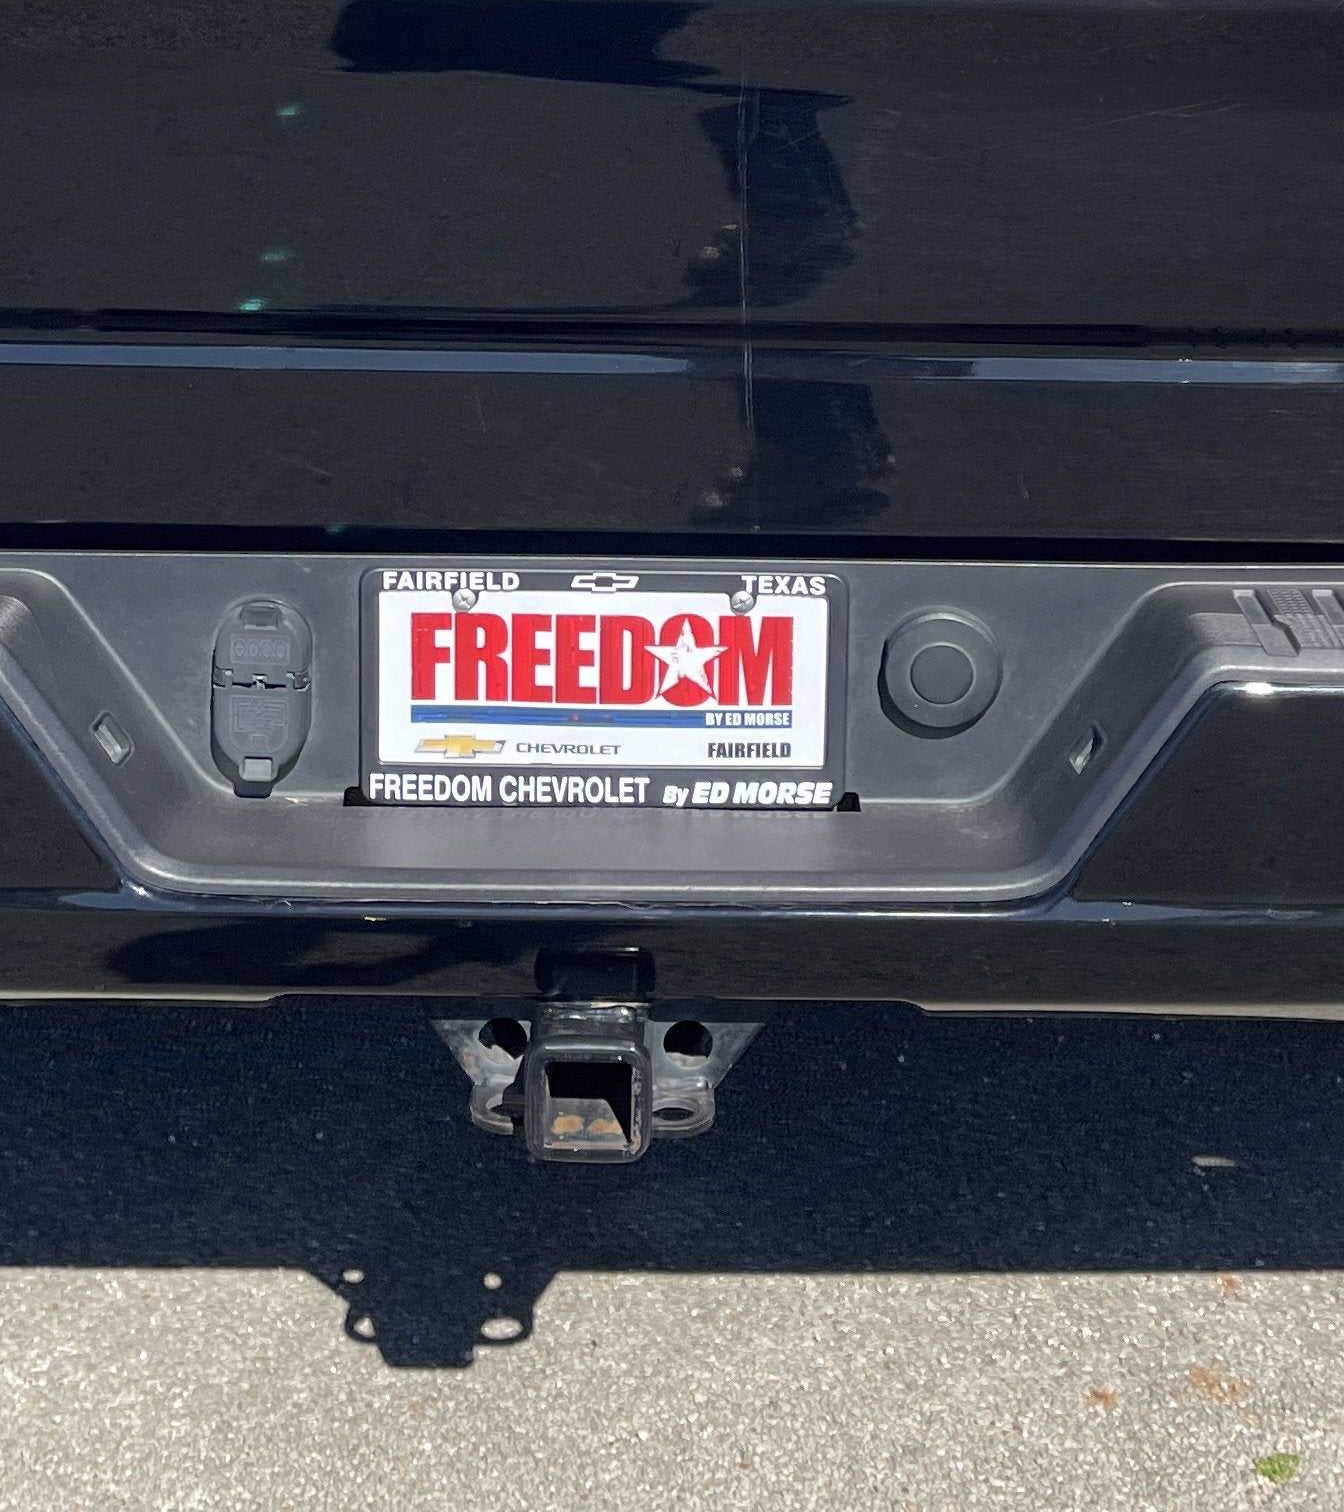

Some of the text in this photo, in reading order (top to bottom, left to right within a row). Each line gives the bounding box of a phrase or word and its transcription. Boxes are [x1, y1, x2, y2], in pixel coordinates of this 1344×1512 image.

[382, 571, 826, 595] FAIRFIELD TEXAS
[411, 612, 794, 707] FREEDOM
[705, 712, 790, 727] BY ED MORSE
[516, 741, 622, 756] CHEVROLET
[707, 742, 792, 759] FAIRFIELD
[368, 772, 834, 807] FREEDOM CHEVROLET By ED MORSE
